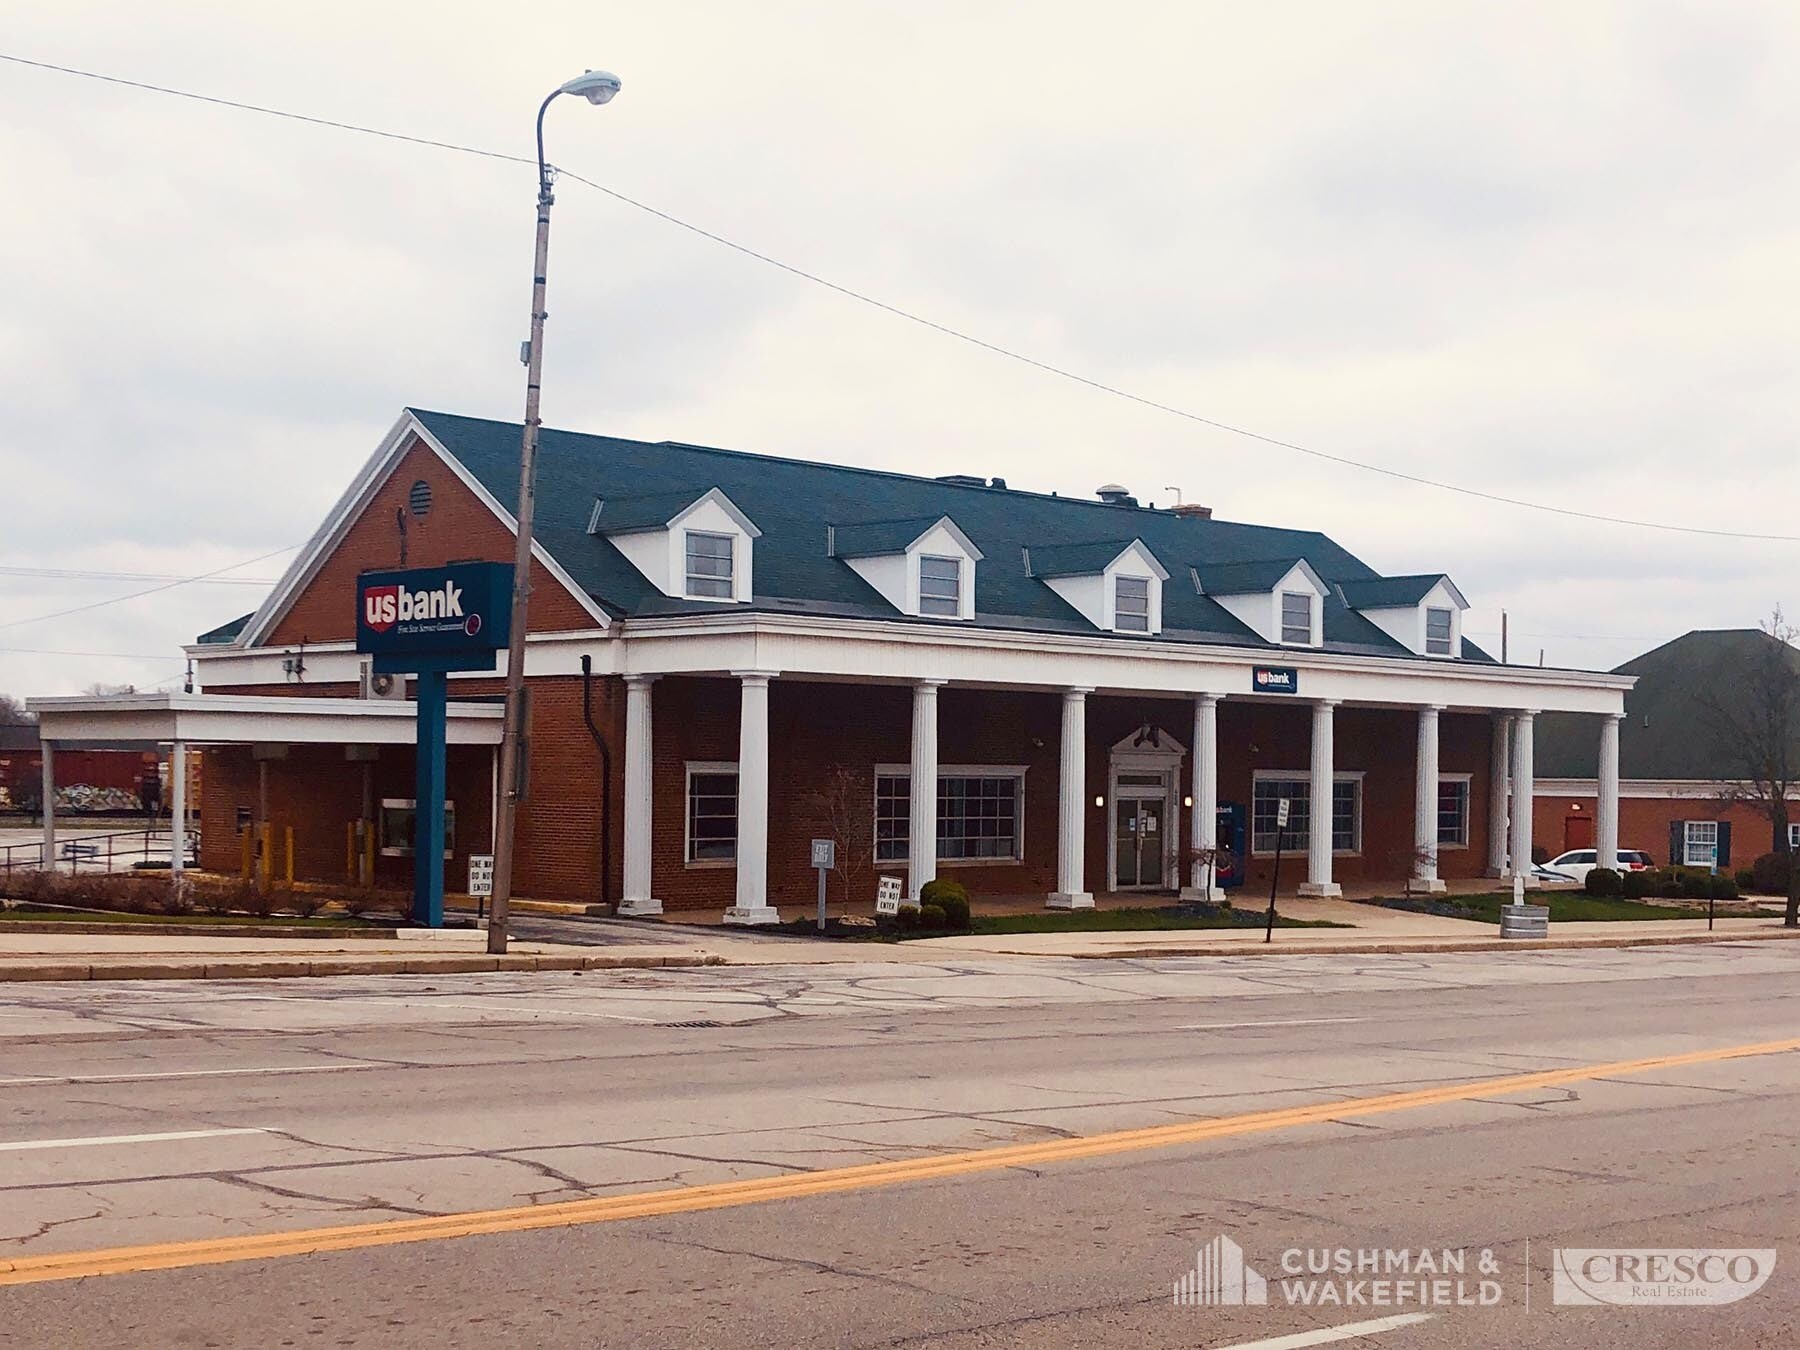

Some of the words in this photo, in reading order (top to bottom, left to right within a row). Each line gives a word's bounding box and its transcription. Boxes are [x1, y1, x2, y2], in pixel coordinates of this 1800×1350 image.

[470, 860, 481, 869] ONE
[484, 860, 493, 869] WA
[471, 871, 480, 880] DO
[482, 871, 492, 880] NO
[473, 883, 491, 892] ENTER
[880, 880, 889, 888] ONE
[891, 882, 901, 891] WAY
[880, 890, 887, 899] DO
[889, 892, 899, 901] NOT
[880, 901, 895, 910] ENTER
